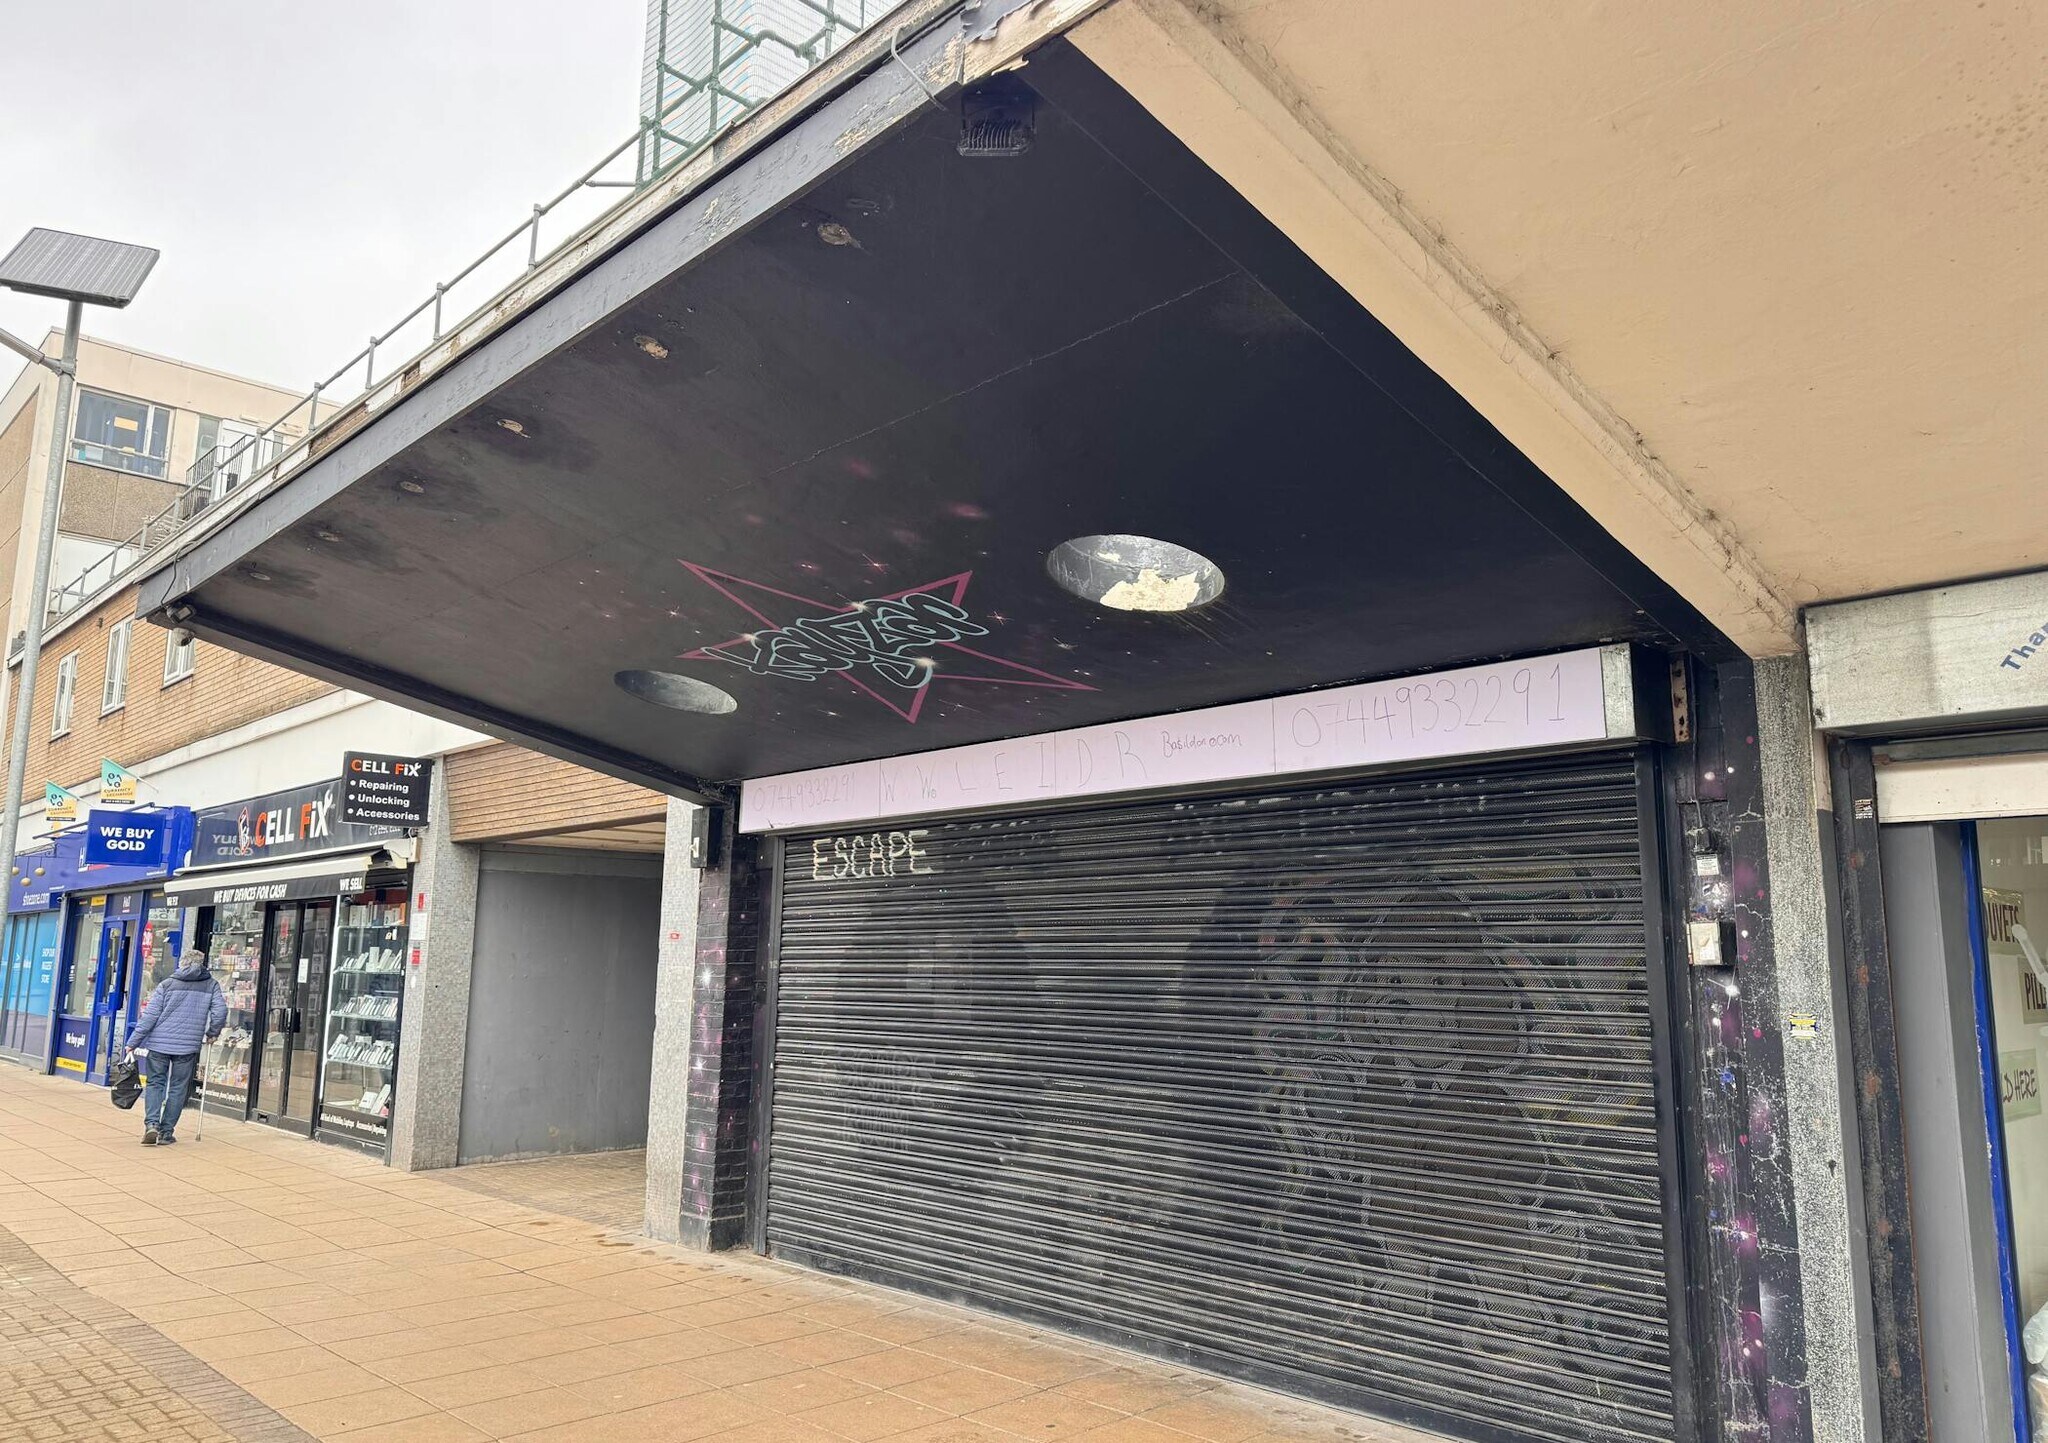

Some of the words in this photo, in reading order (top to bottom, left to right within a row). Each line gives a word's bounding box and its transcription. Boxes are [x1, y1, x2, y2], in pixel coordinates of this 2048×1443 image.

[2000, 621, 2048, 670] Tha
[1291, 664, 1566, 748] 07449332291
[351, 759, 390, 775] CELL
[358, 779, 409, 794] Repairing
[752, 771, 856, 812] 07449332291
[357, 793, 410, 808] Unlocking
[355, 807, 420, 821] Accessories
[100, 826, 122, 838] WE
[126, 828, 155, 840] BUY
[255, 807, 295, 848] CELL
[106, 839, 146, 852] GOLD
[812, 829, 935, 881] ESCAPE
[339, 878, 350, 891] WE
[350, 877, 363, 890] SELL
[213, 890, 224, 904] WE
[223, 889, 235, 904] BUY
[256, 885, 270, 900] FOR
[269, 884, 288, 899] CASH
[2013, 1068, 2037, 1101] HERE
